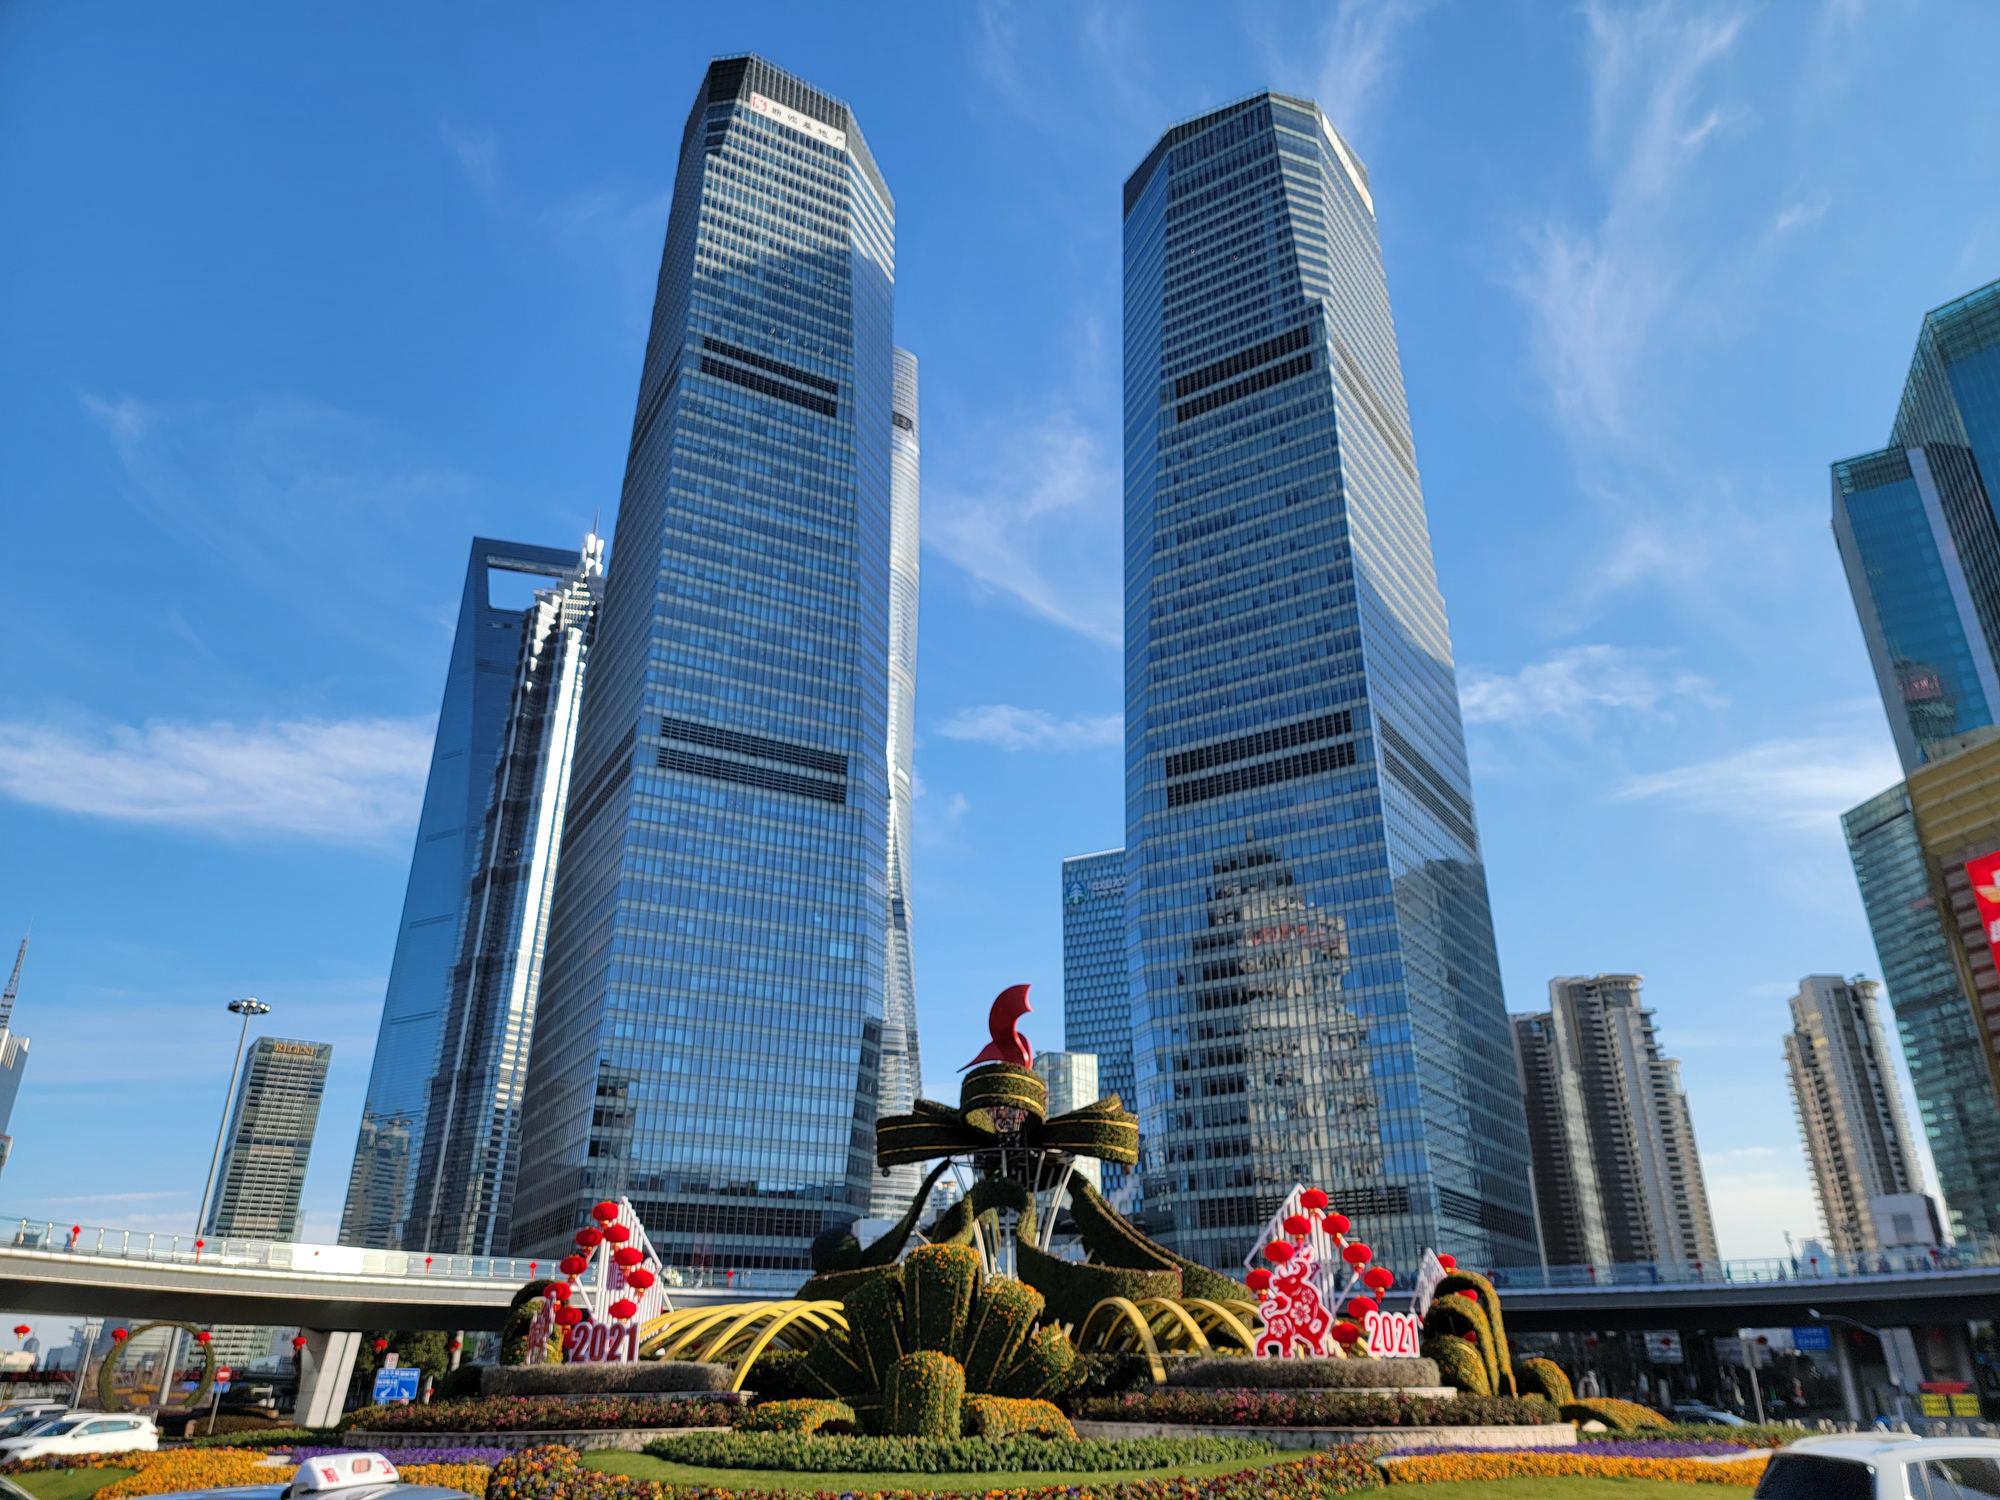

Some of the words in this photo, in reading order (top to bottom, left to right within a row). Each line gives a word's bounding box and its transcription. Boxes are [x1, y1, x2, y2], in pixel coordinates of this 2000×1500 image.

[274, 1043, 316, 1056] REGENT
[571, 1323, 637, 1362] 2021
[1369, 1316, 1417, 1354] 2021
